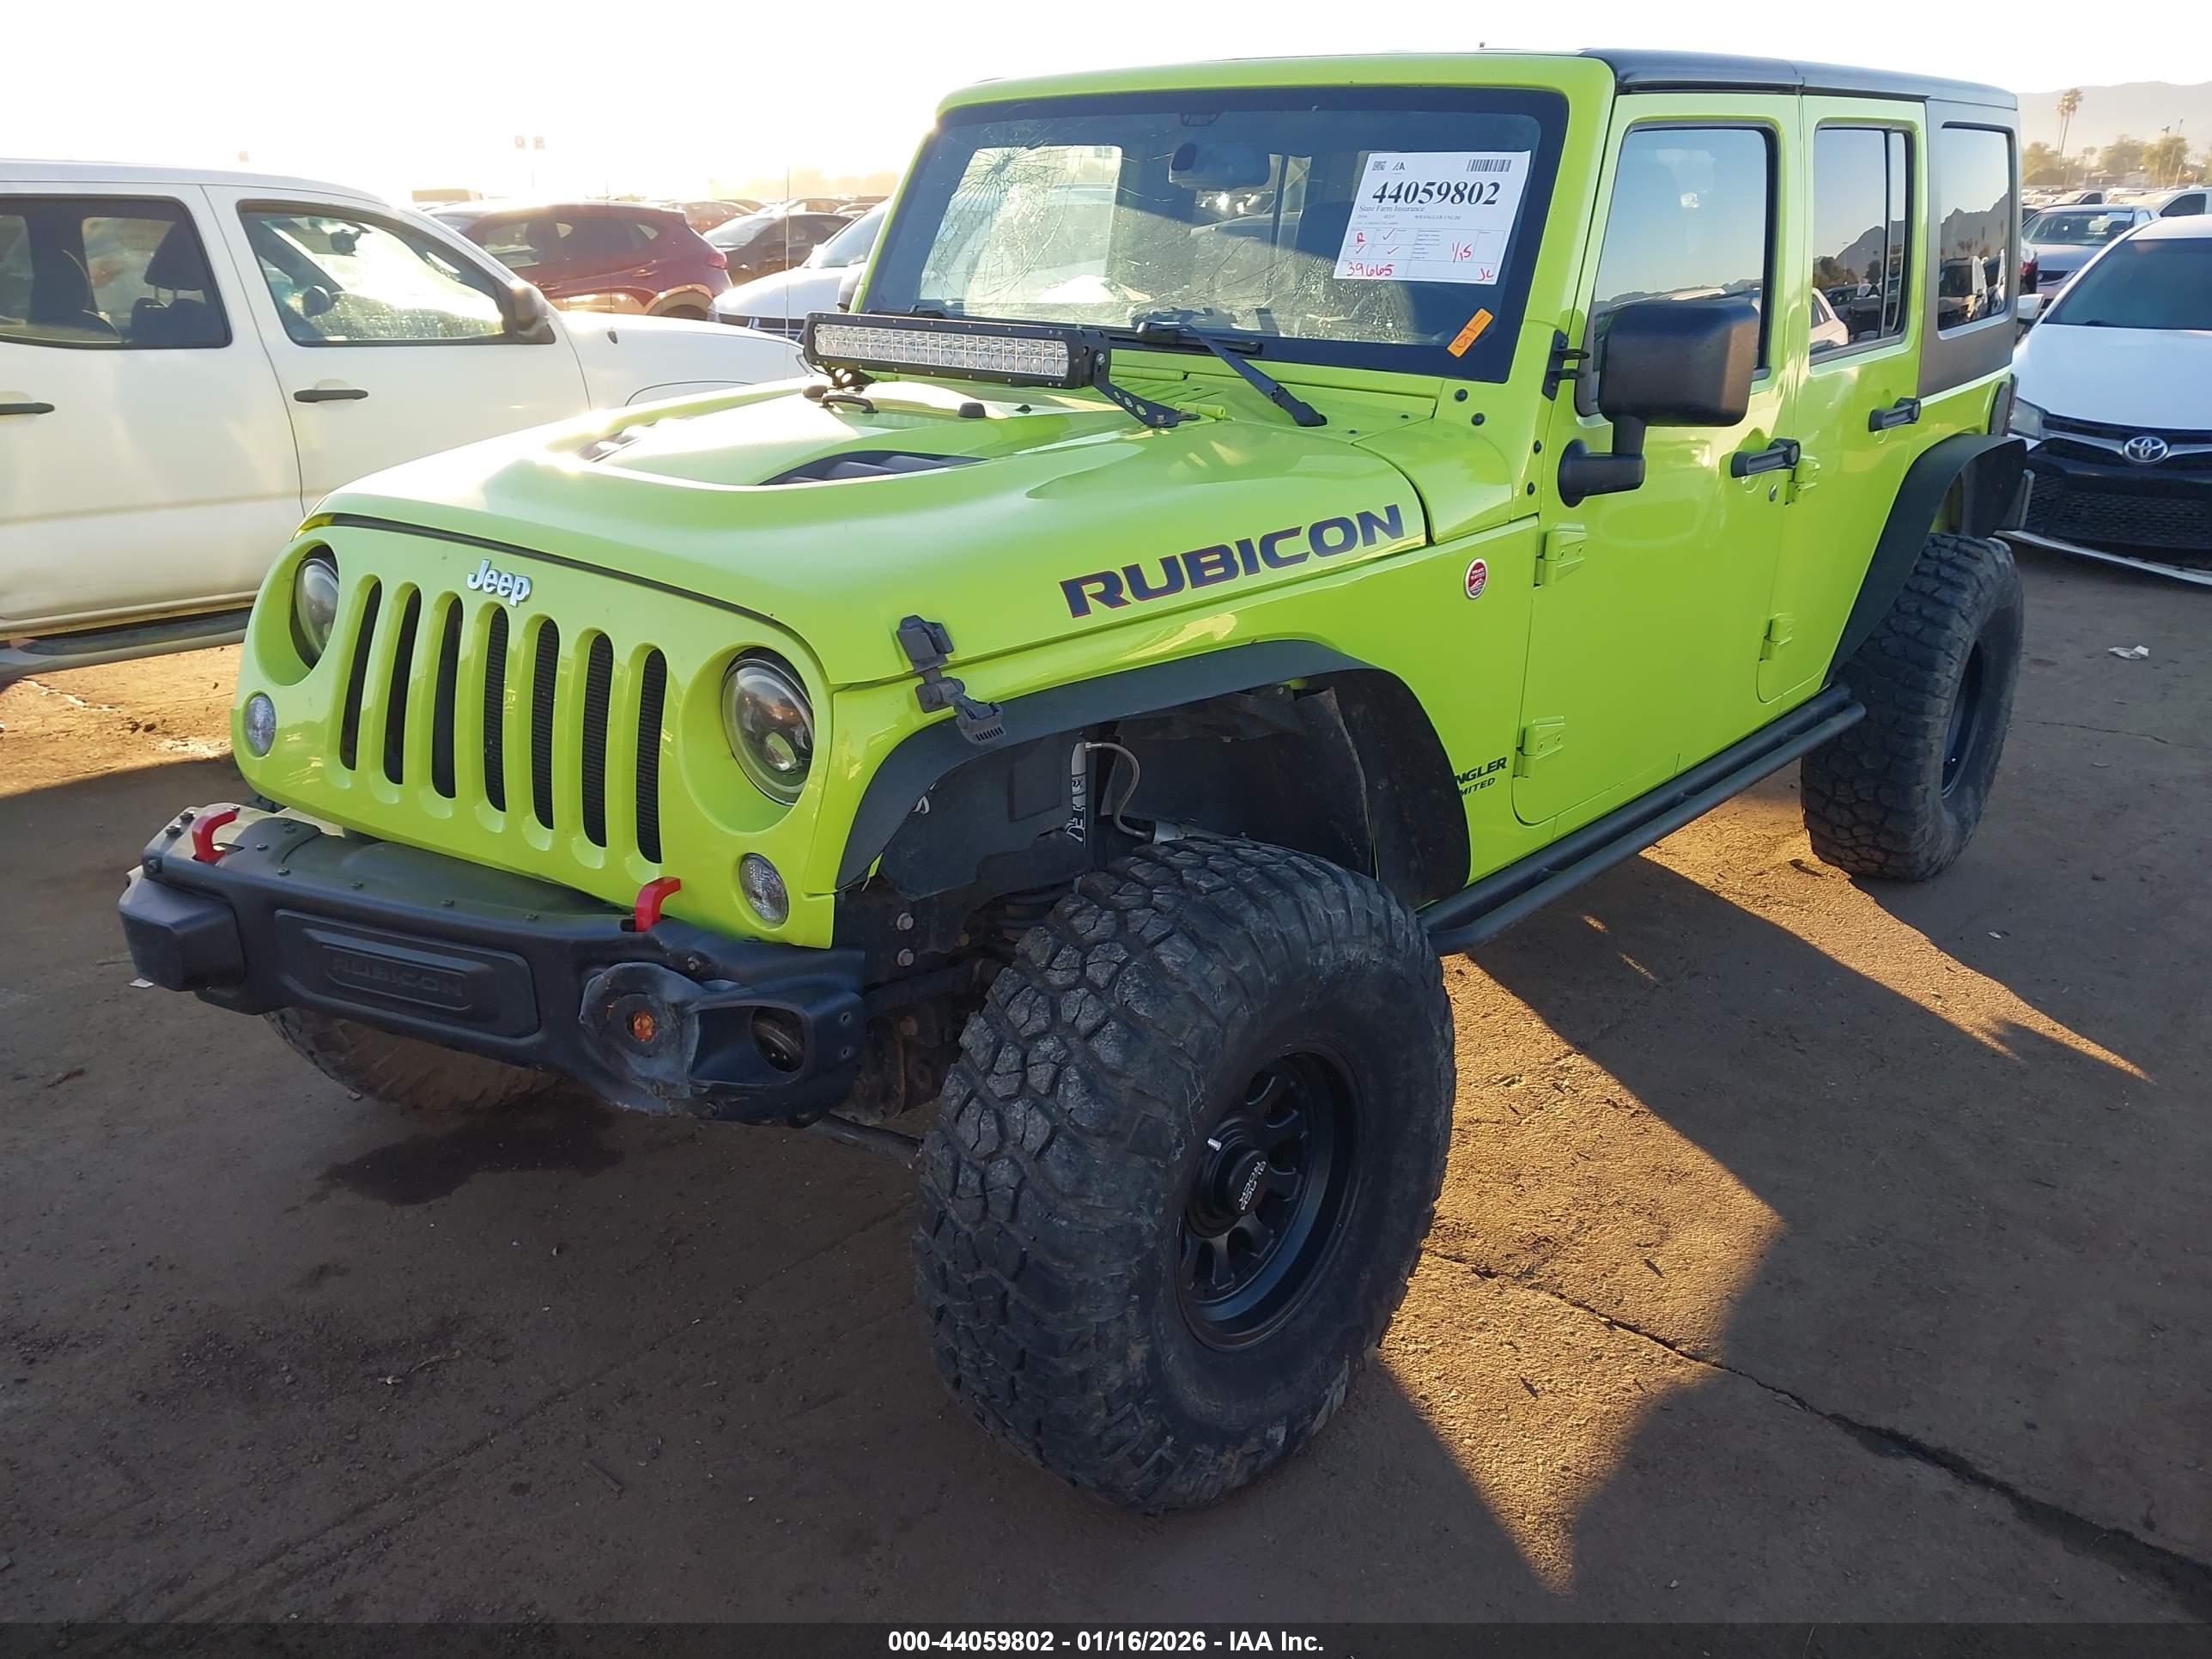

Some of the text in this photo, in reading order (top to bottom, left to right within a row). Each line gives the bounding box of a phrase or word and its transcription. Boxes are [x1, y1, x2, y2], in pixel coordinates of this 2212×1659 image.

[1372, 180, 1500, 205] 44059802
[467, 558, 533, 607] Jeep
[1058, 503, 1405, 619] RUBICON
